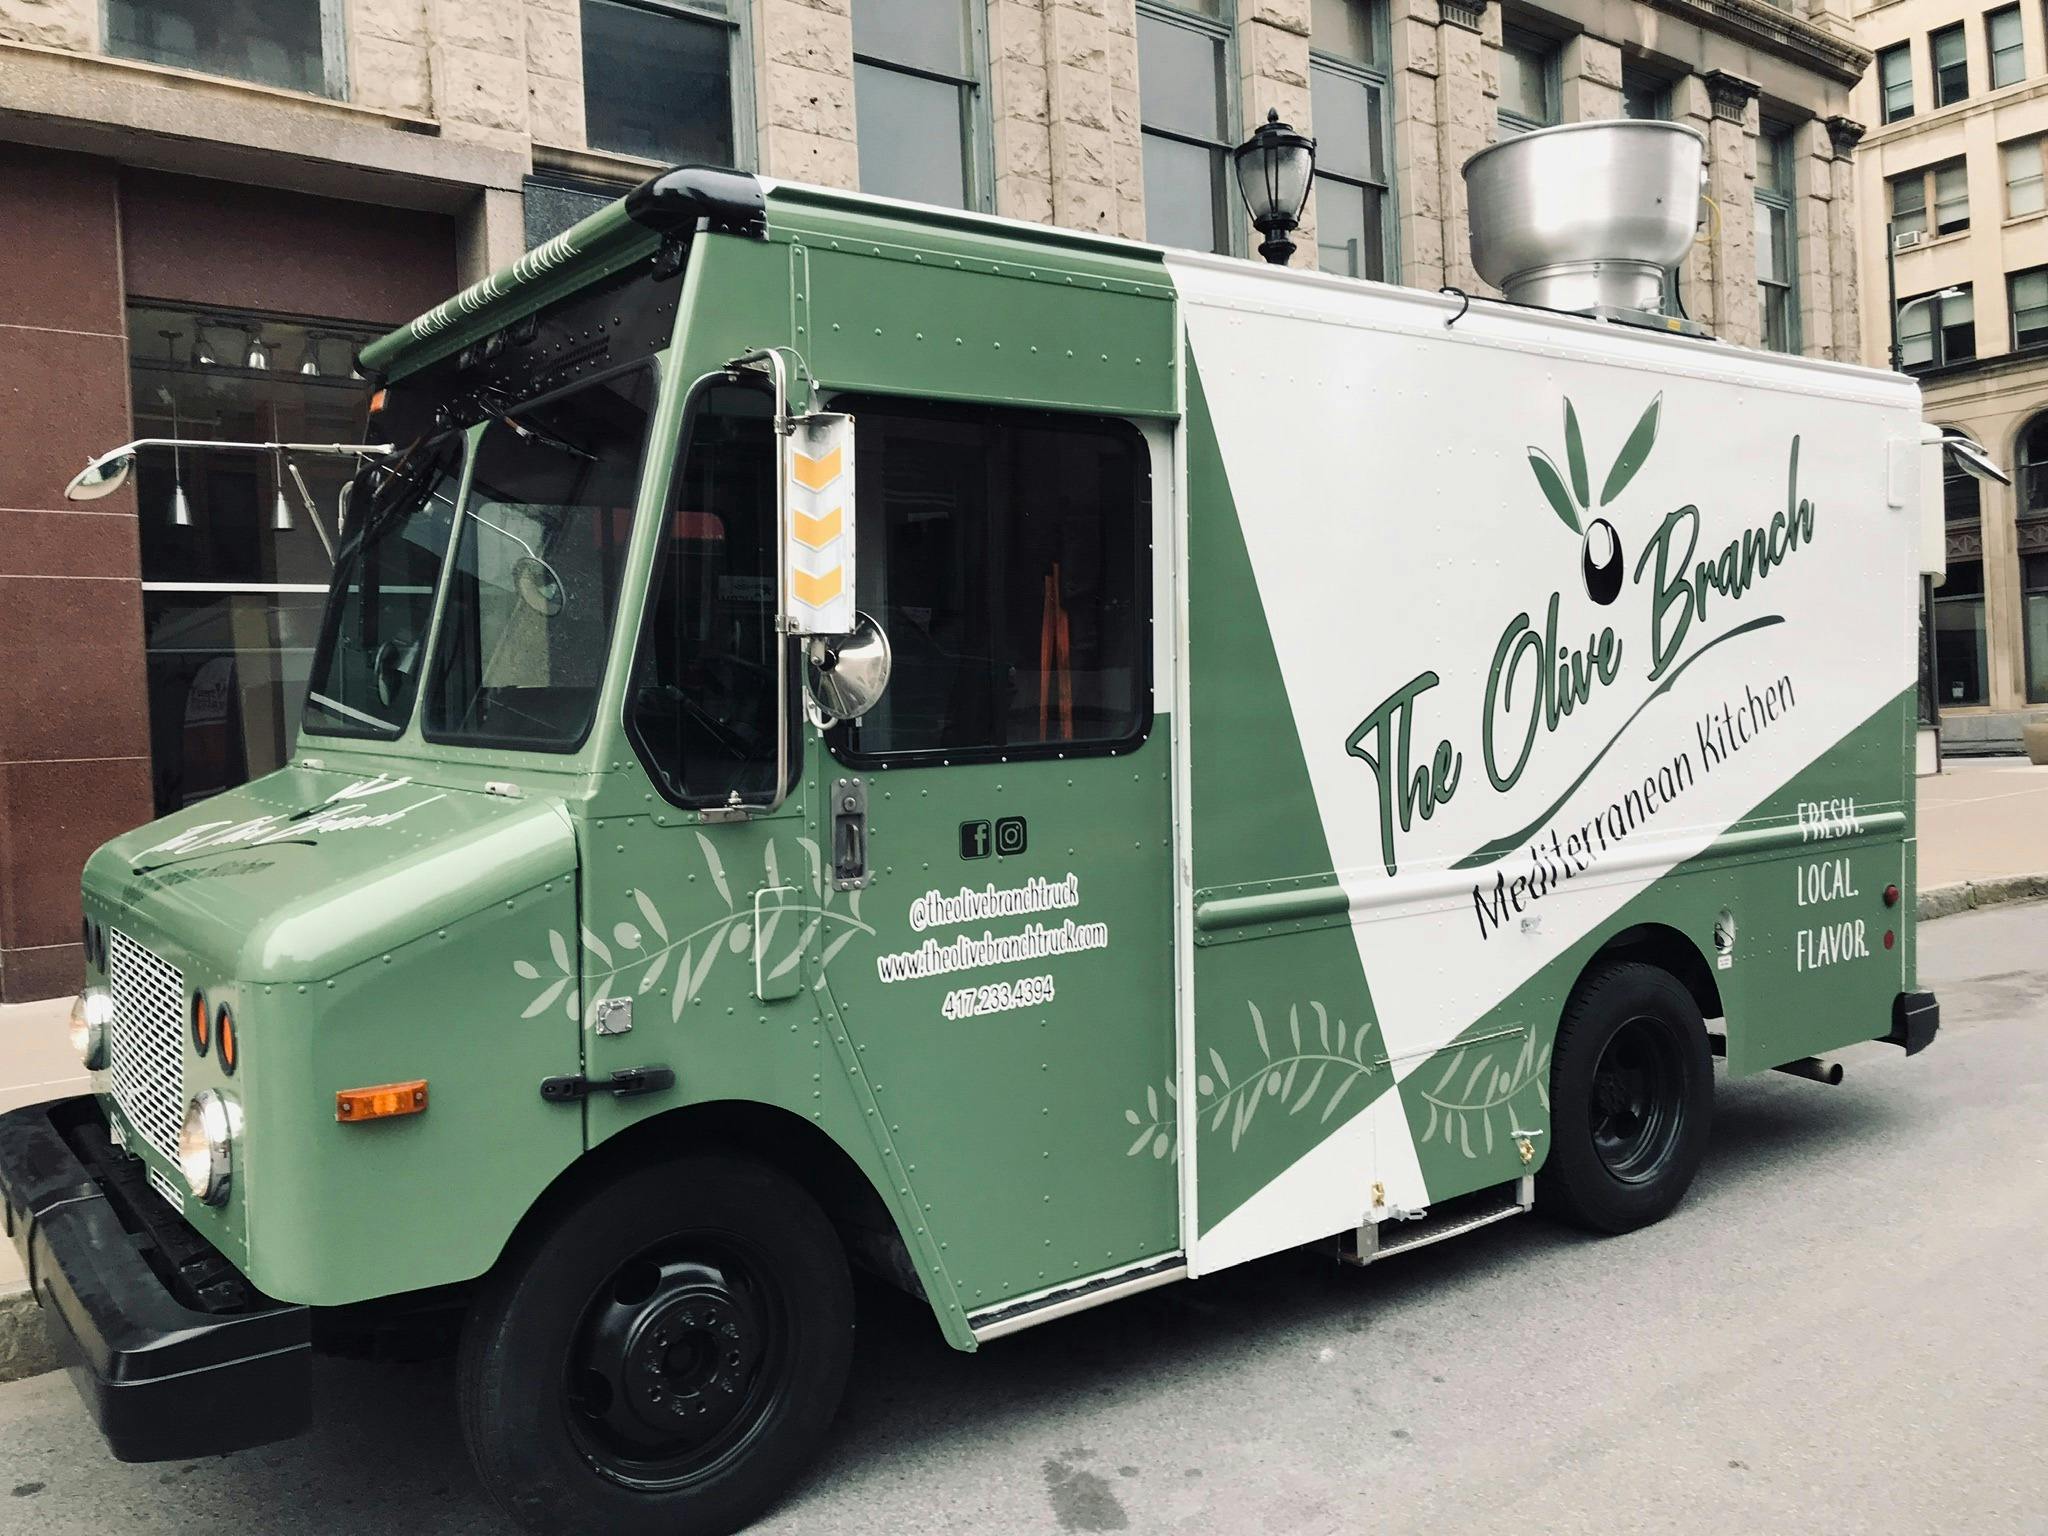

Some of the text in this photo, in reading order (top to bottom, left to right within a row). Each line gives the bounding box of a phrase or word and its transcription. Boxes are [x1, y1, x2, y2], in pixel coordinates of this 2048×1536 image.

[1345, 434, 1816, 877] The Olive Branch
[1472, 674, 1797, 941] Mediterranean Kitchen
[1797, 797, 1865, 843] FRESH.
[911, 873, 1079, 931] @theolivebranchtruck
[1797, 857, 1860, 907] LOCAL.
[878, 919, 1108, 982] www.theolivebranchtruck.com
[1796, 919, 1870, 972] FLAVOR.
[942, 975, 1055, 1020] 417.233.4394
